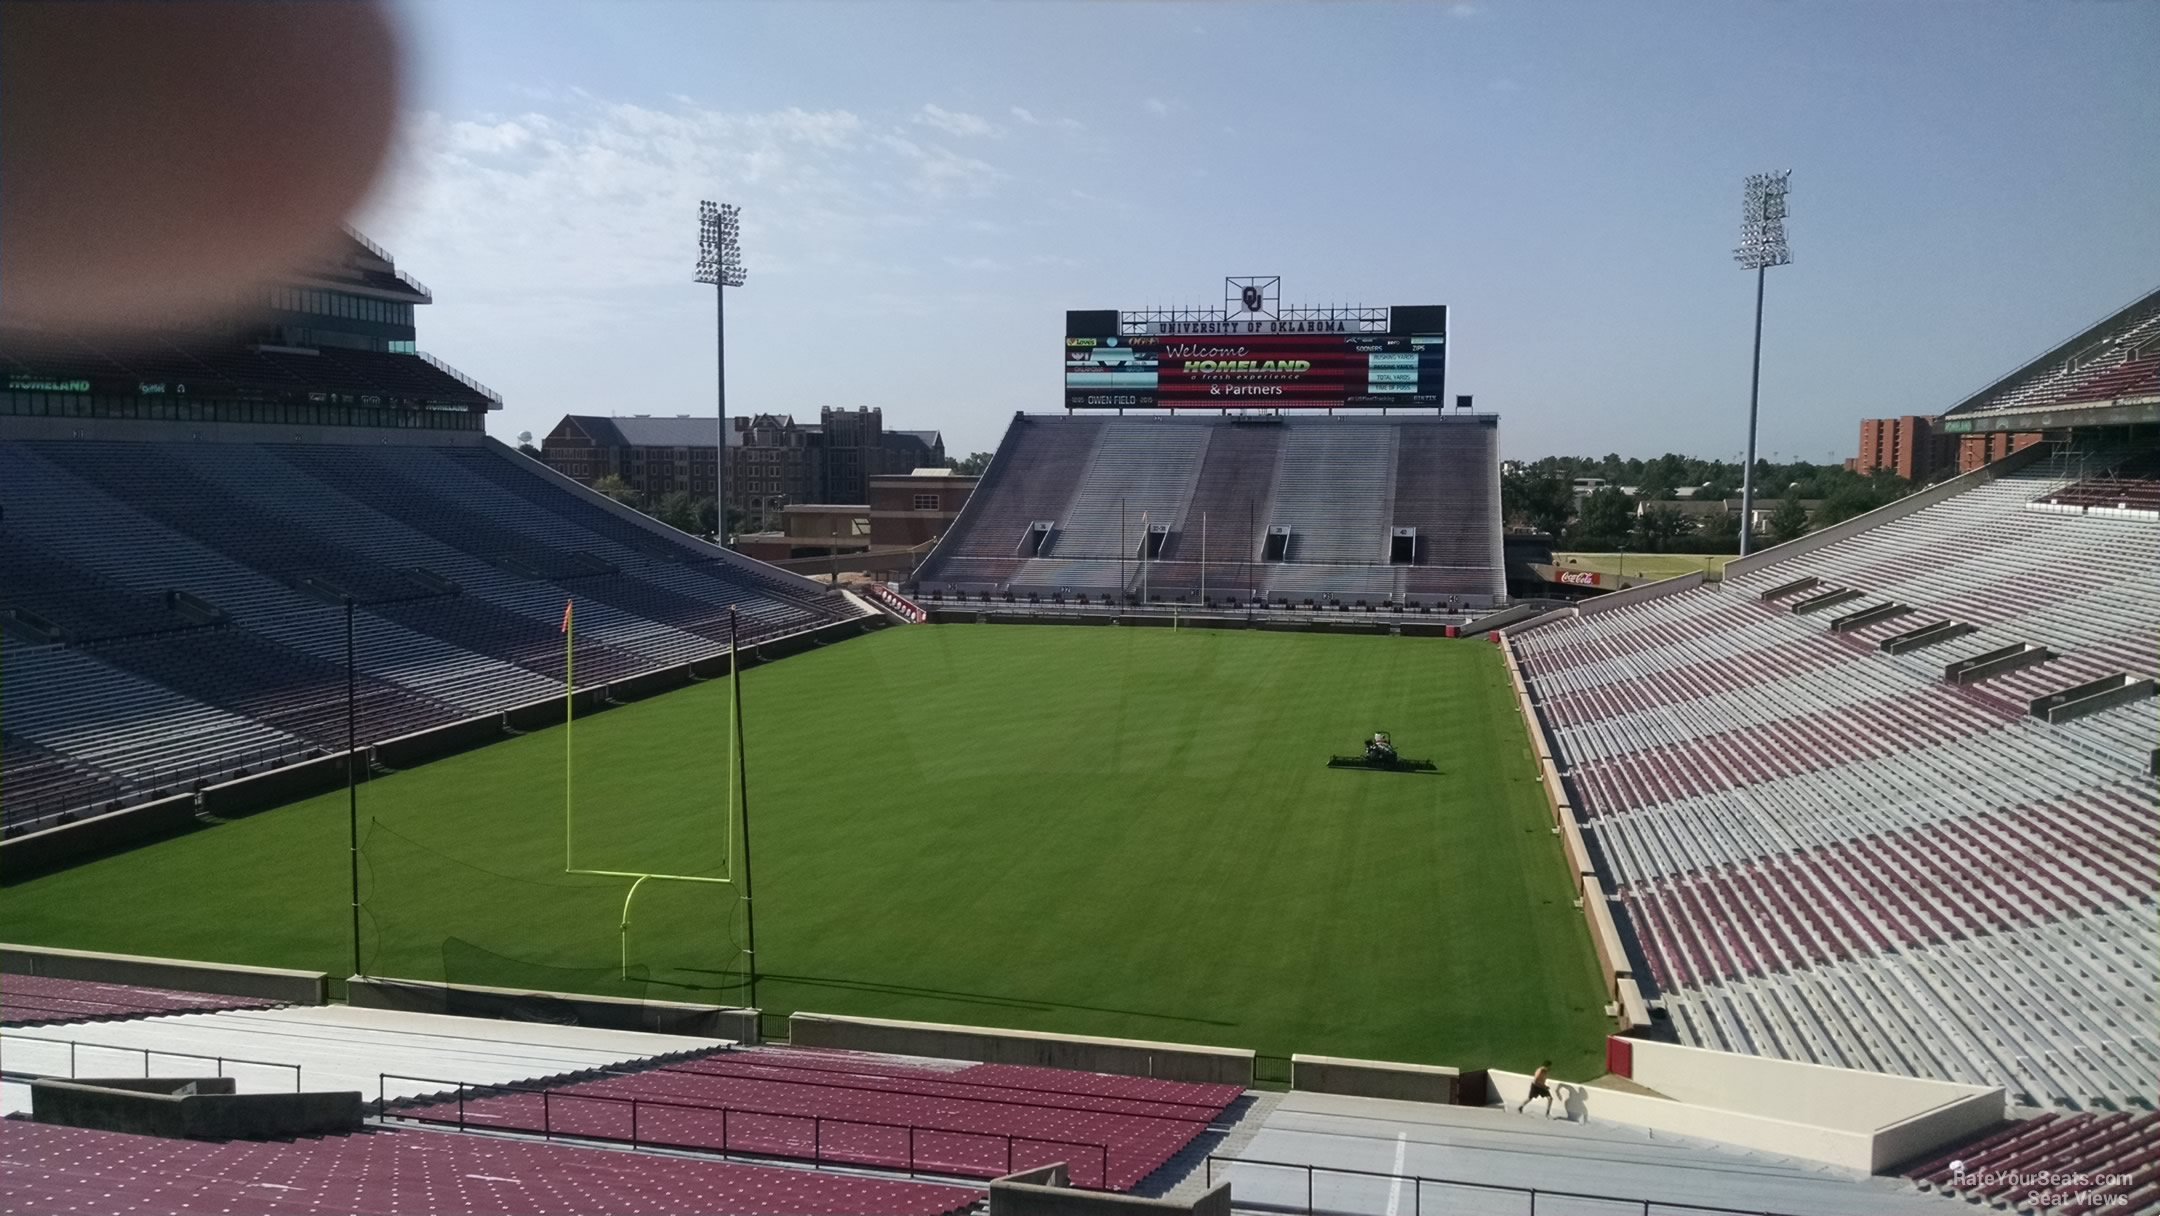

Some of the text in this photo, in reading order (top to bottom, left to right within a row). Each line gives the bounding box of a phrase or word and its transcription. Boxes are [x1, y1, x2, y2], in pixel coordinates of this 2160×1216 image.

[1243, 286, 1262, 312] OU
[1159, 321, 1345, 334] UNIVERSITY OF OKLAHOMA
[1166, 343, 1249, 358] Welcome
[1183, 360, 1311, 373] HOMELAND
[1236, 373, 1300, 381] experience
[1210, 384, 1283, 395] & Partners
[1088, 395, 1112, 405] OWEN
[1114, 395, 1136, 405] FIELD
